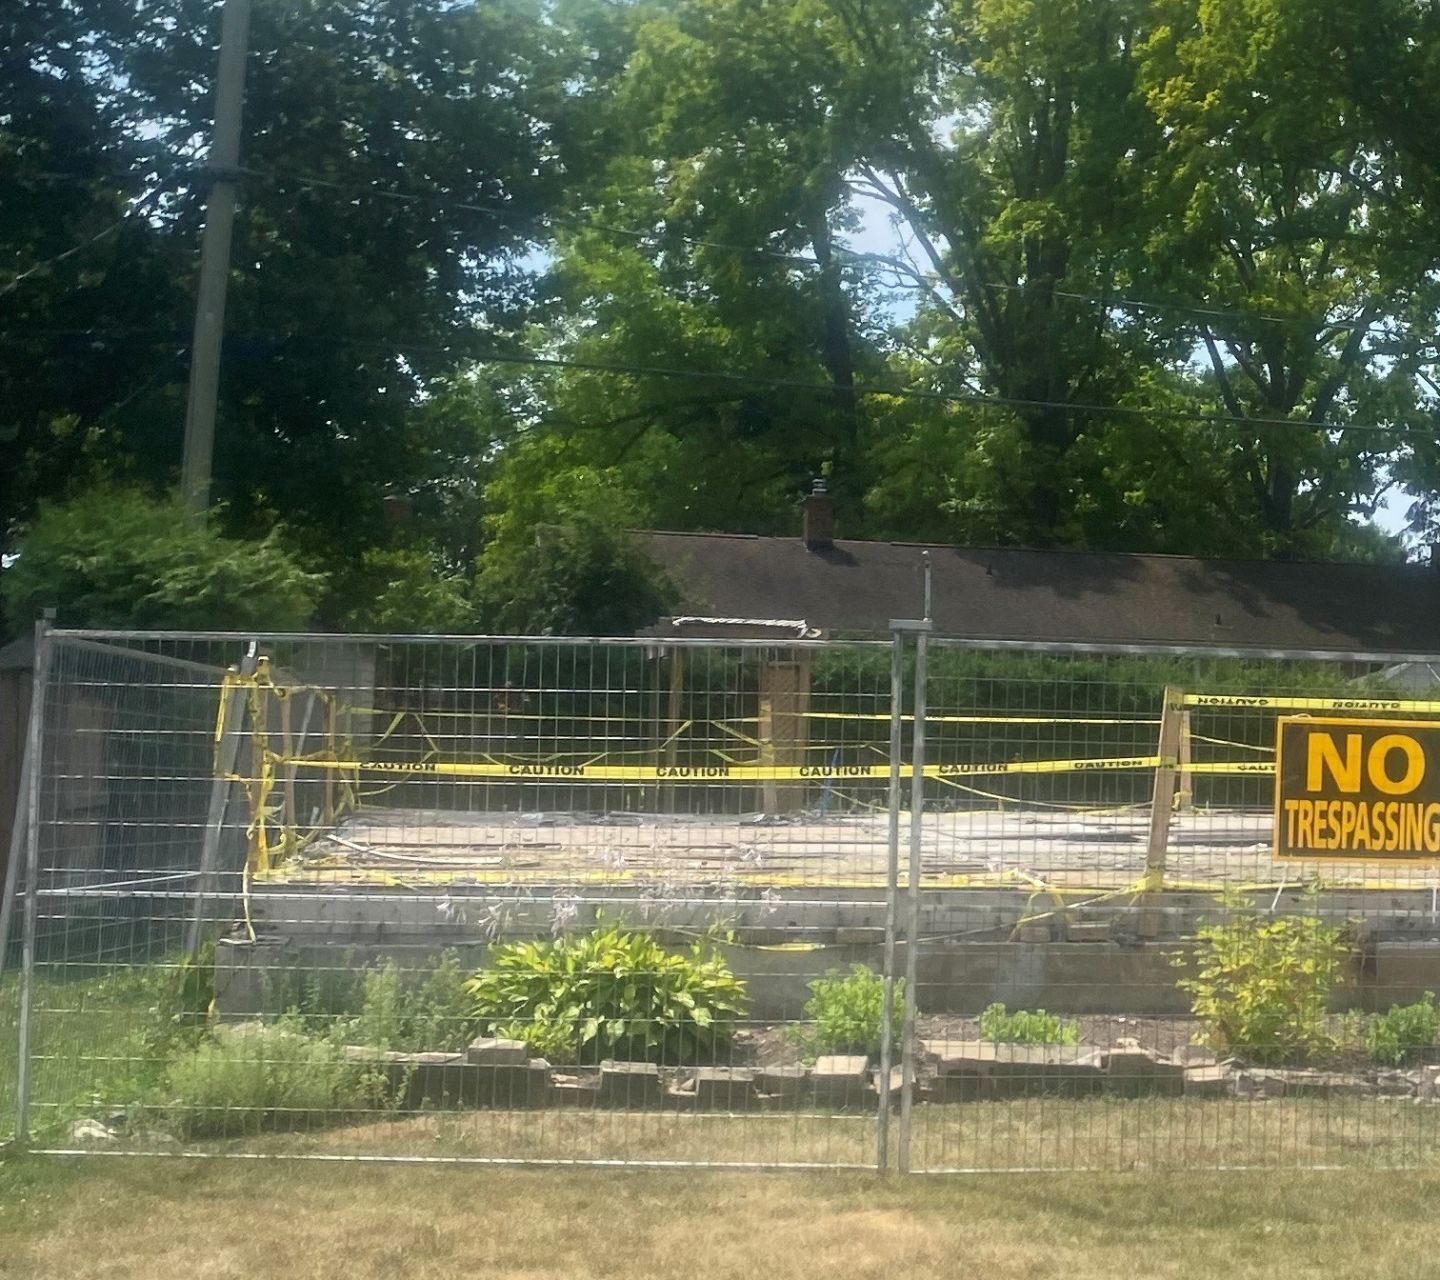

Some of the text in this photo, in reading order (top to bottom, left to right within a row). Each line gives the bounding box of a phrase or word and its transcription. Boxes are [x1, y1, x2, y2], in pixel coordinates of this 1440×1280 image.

[1197, 696, 1269, 706] CAUTION
[1332, 701, 1401, 710] CAUTION
[508, 764, 585, 776] CAUTION
[938, 763, 1008, 775] CAUTION
[1074, 759, 1143, 769] CAUTION
[1306, 732, 1426, 796] NO
[656, 766, 730, 778] CAUTION
[799, 765, 871, 778] CAUTION
